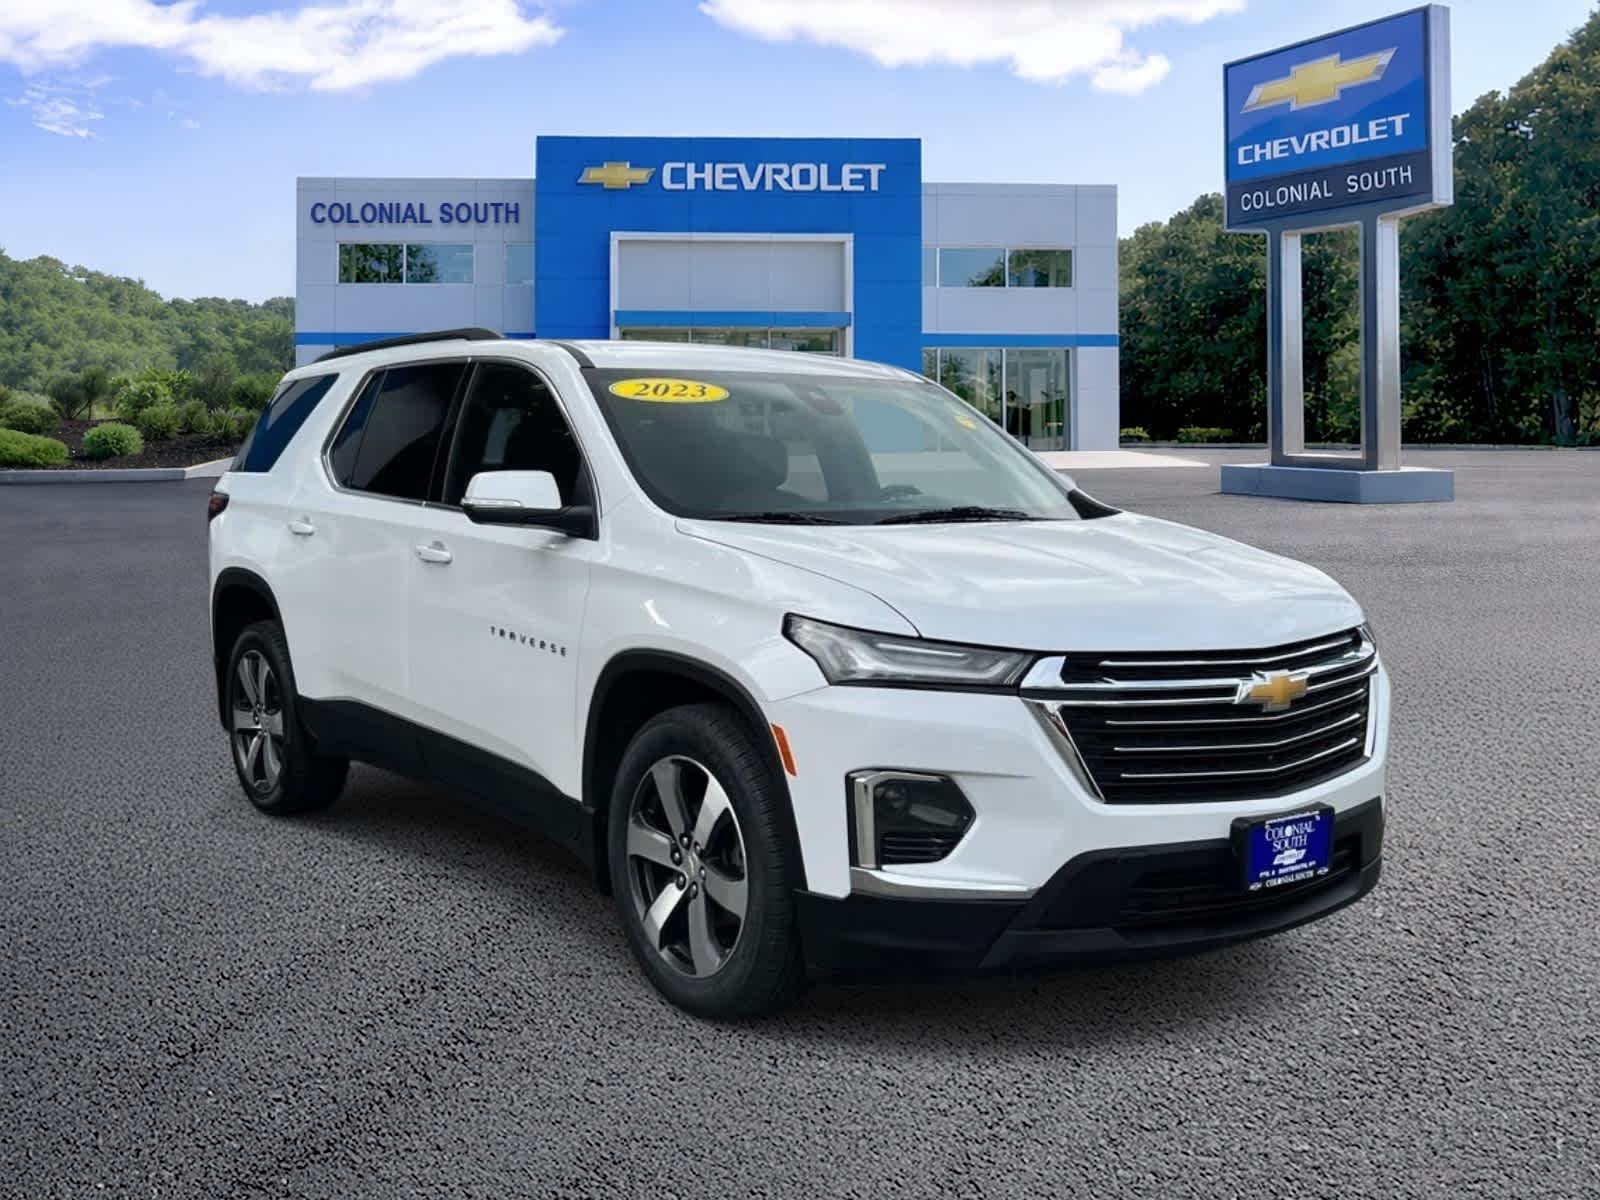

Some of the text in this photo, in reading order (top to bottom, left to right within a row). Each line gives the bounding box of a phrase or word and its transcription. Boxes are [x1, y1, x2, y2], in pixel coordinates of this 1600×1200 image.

[1238, 112, 1410, 165] CHEVROLET
[662, 162, 887, 191] CHEVROLET
[1240, 165, 1413, 211] COLONIAL SOUTH
[310, 202, 520, 224] COLONIAL SOUTH
[633, 382, 708, 398] 2023
[490, 625, 567, 657] TRAVERSE
[1264, 820, 1316, 842] COLONIAL
[1272, 834, 1308, 852] SOUTH
